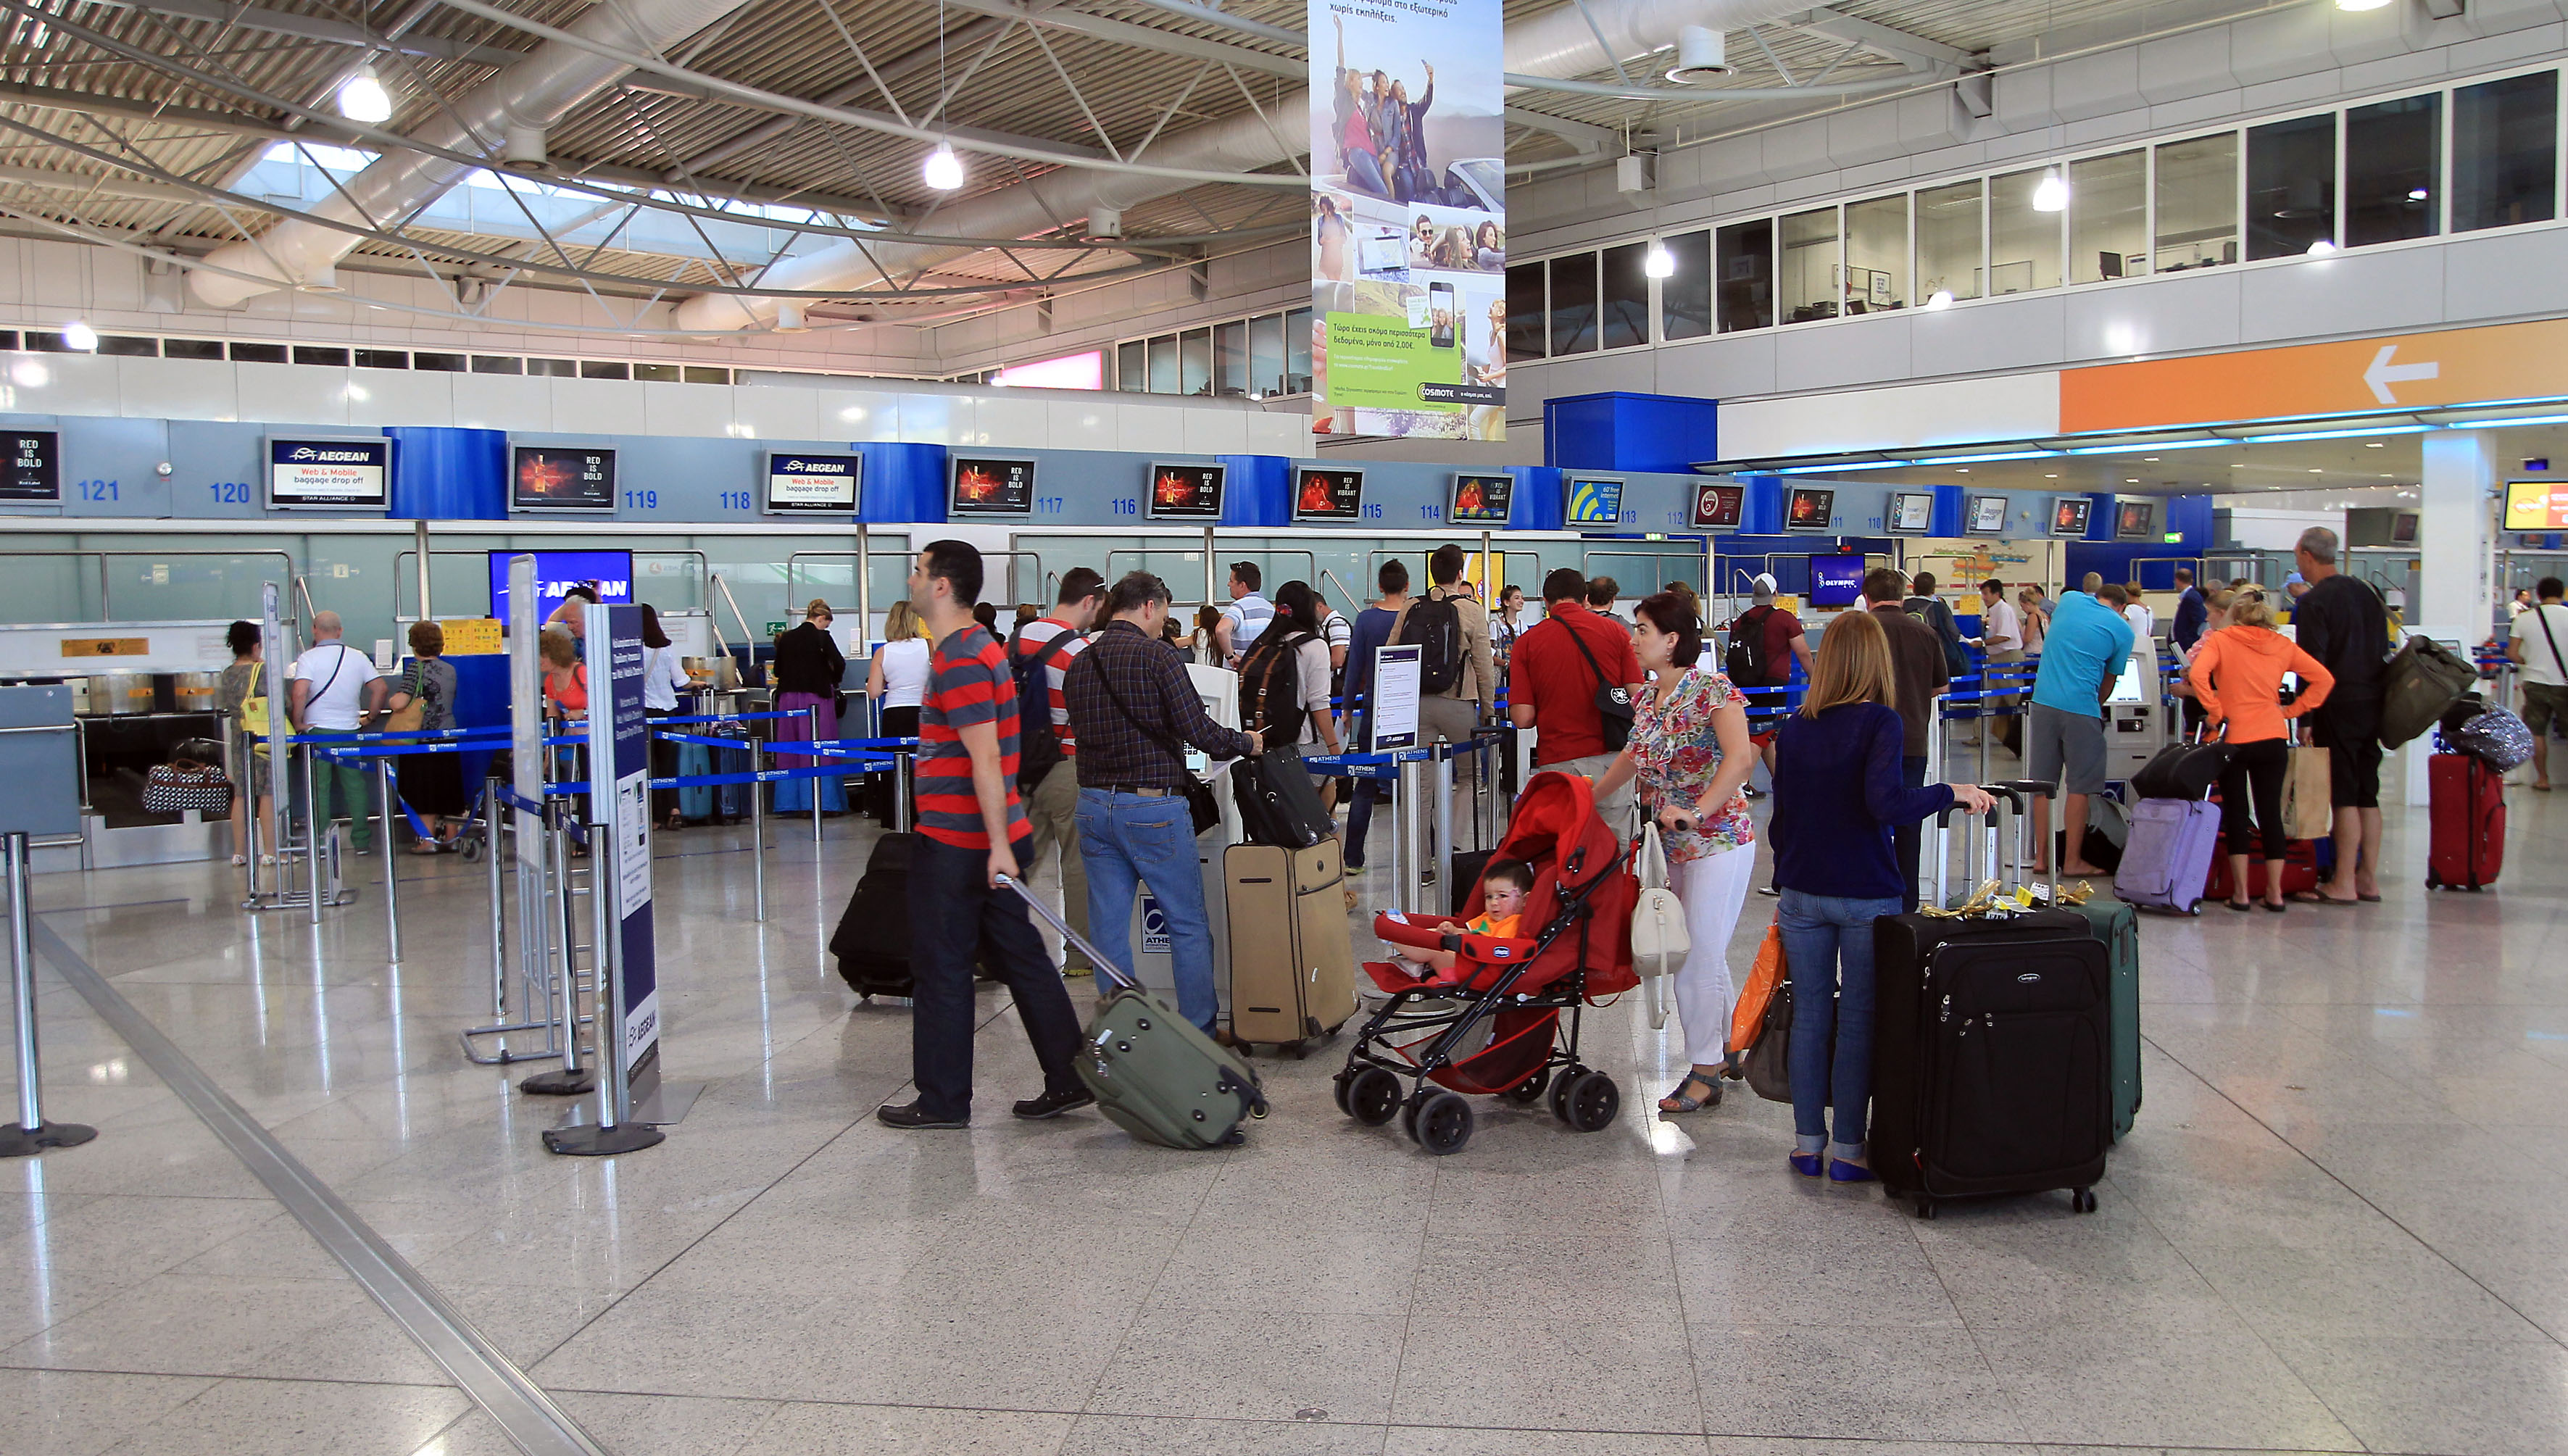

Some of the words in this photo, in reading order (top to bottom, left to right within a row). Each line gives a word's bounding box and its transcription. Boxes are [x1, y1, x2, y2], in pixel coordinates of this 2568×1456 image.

[1329, 3, 1353, 14] χωρίς
[1355, 8, 1397, 23] εκπλήξεις.
[1410, 4, 1448, 18] εξωτερικό
[1334, 323, 1350, 333] Τώρα
[1368, 327, 1388, 336] ακόμα
[1389, 329, 1426, 339] περισσότερα
[1421, 388, 1454, 398] COSMOTE
[20, 439, 38, 449] RED
[25, 449, 34, 458] IS
[317, 452, 370, 462] AEGEAN
[586, 456, 601, 465] RED
[17, 458, 42, 468] BOLD
[805, 463, 845, 473] AEGEAN
[294, 476, 330, 485] baggage
[78, 479, 119, 501] 121
[210, 482, 250, 504] 120
[626, 490, 657, 509] 119
[720, 491, 751, 509] 118
[1038, 496, 1063, 513] 117
[1112, 498, 1136, 515] 116
[1363, 504, 1382, 519] 115
[1421, 504, 1439, 519] 114
[1621, 509, 1637, 523] 113
[1667, 511, 1683, 525] 112
[1868, 517, 1882, 529] 110
[546, 581, 628, 598] AEAN
